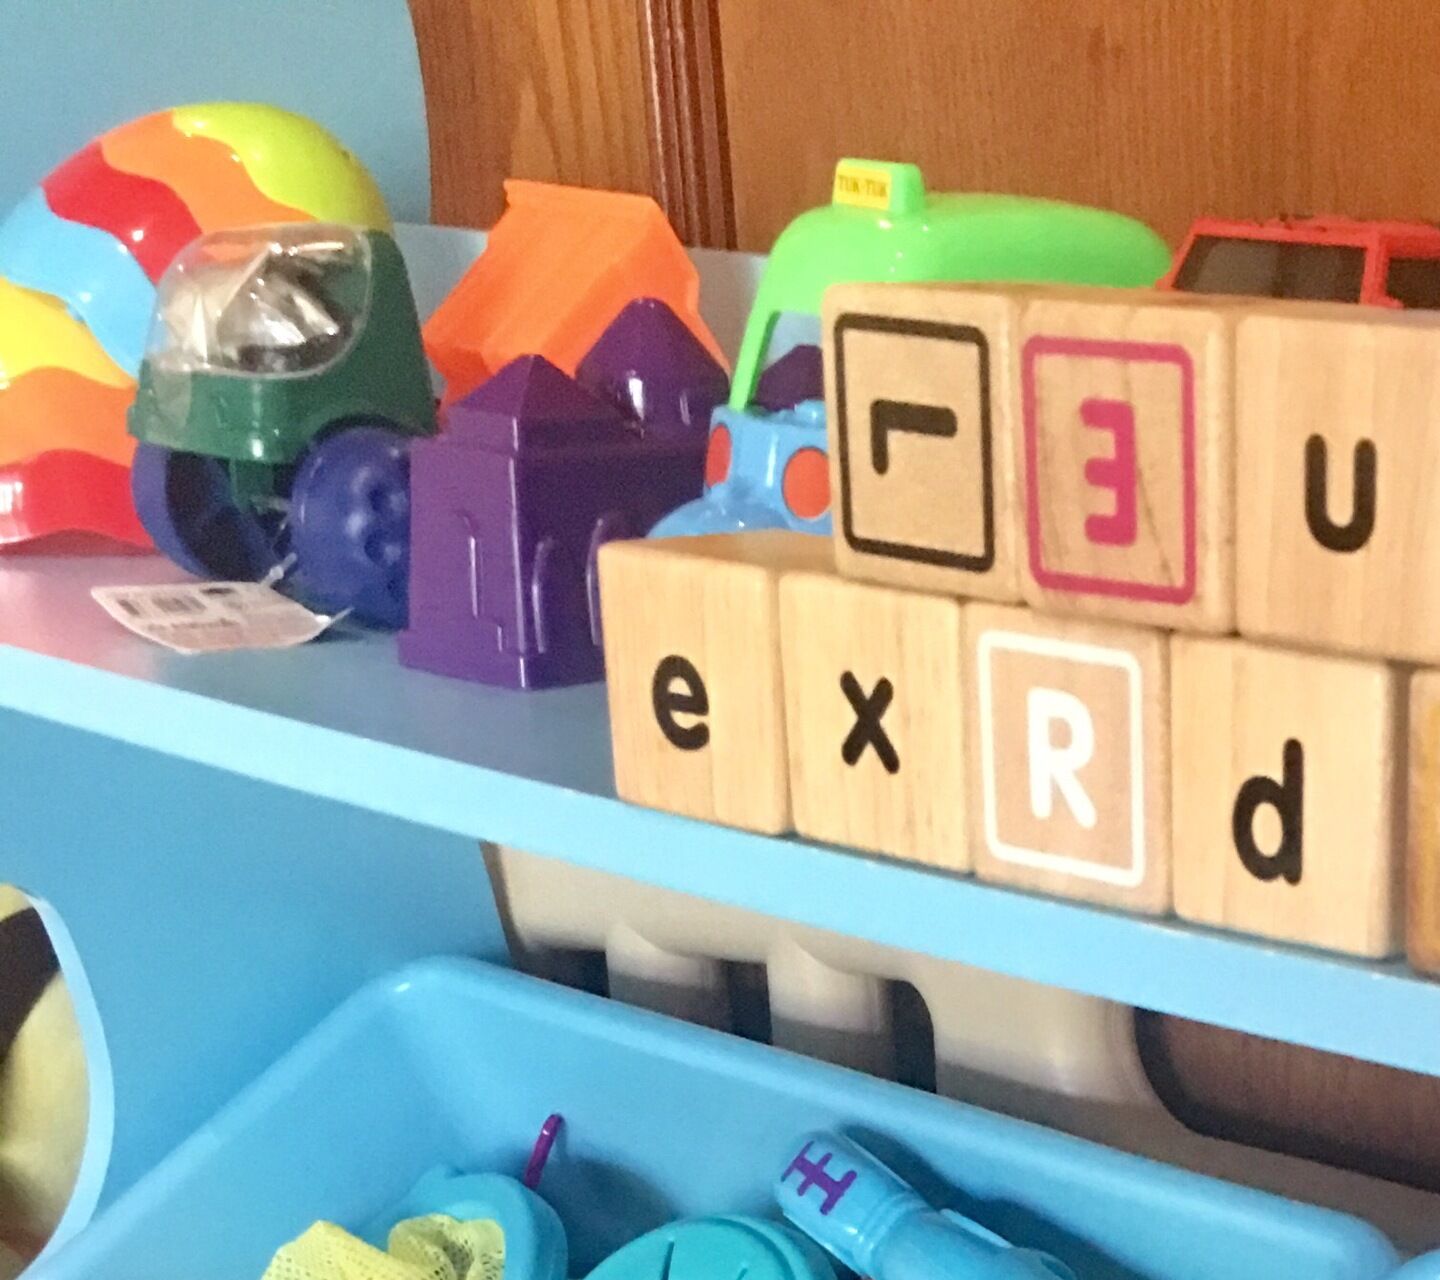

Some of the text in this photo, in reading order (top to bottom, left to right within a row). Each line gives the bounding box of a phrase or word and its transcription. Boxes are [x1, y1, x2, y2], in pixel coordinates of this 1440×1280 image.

[651, 654, 711, 753] e
[1026, 686, 1098, 830] R
[1231, 738, 1306, 887] d
